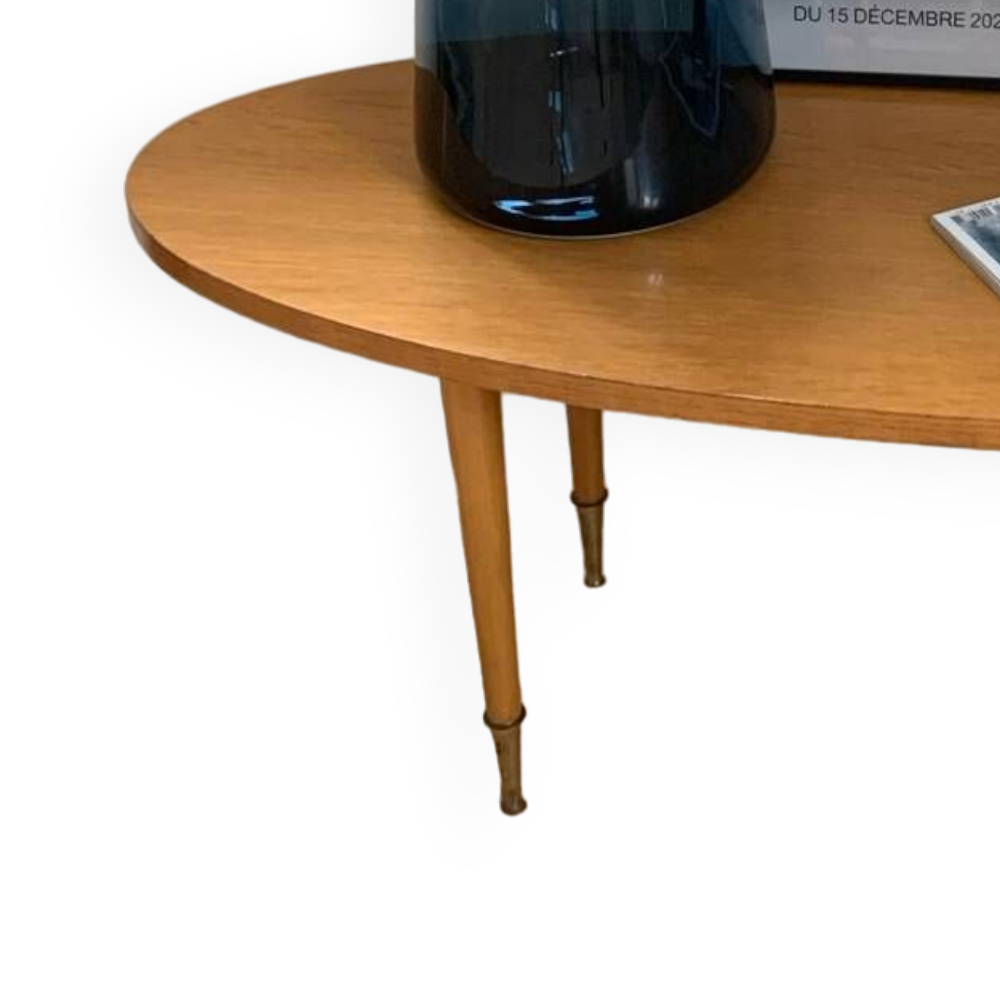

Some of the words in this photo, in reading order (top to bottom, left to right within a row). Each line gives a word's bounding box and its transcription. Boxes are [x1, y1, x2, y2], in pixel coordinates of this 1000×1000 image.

[793, 5, 822, 22] DU
[828, 7, 849, 23] 15
[854, 5, 965, 28] DÉCEMBRE
